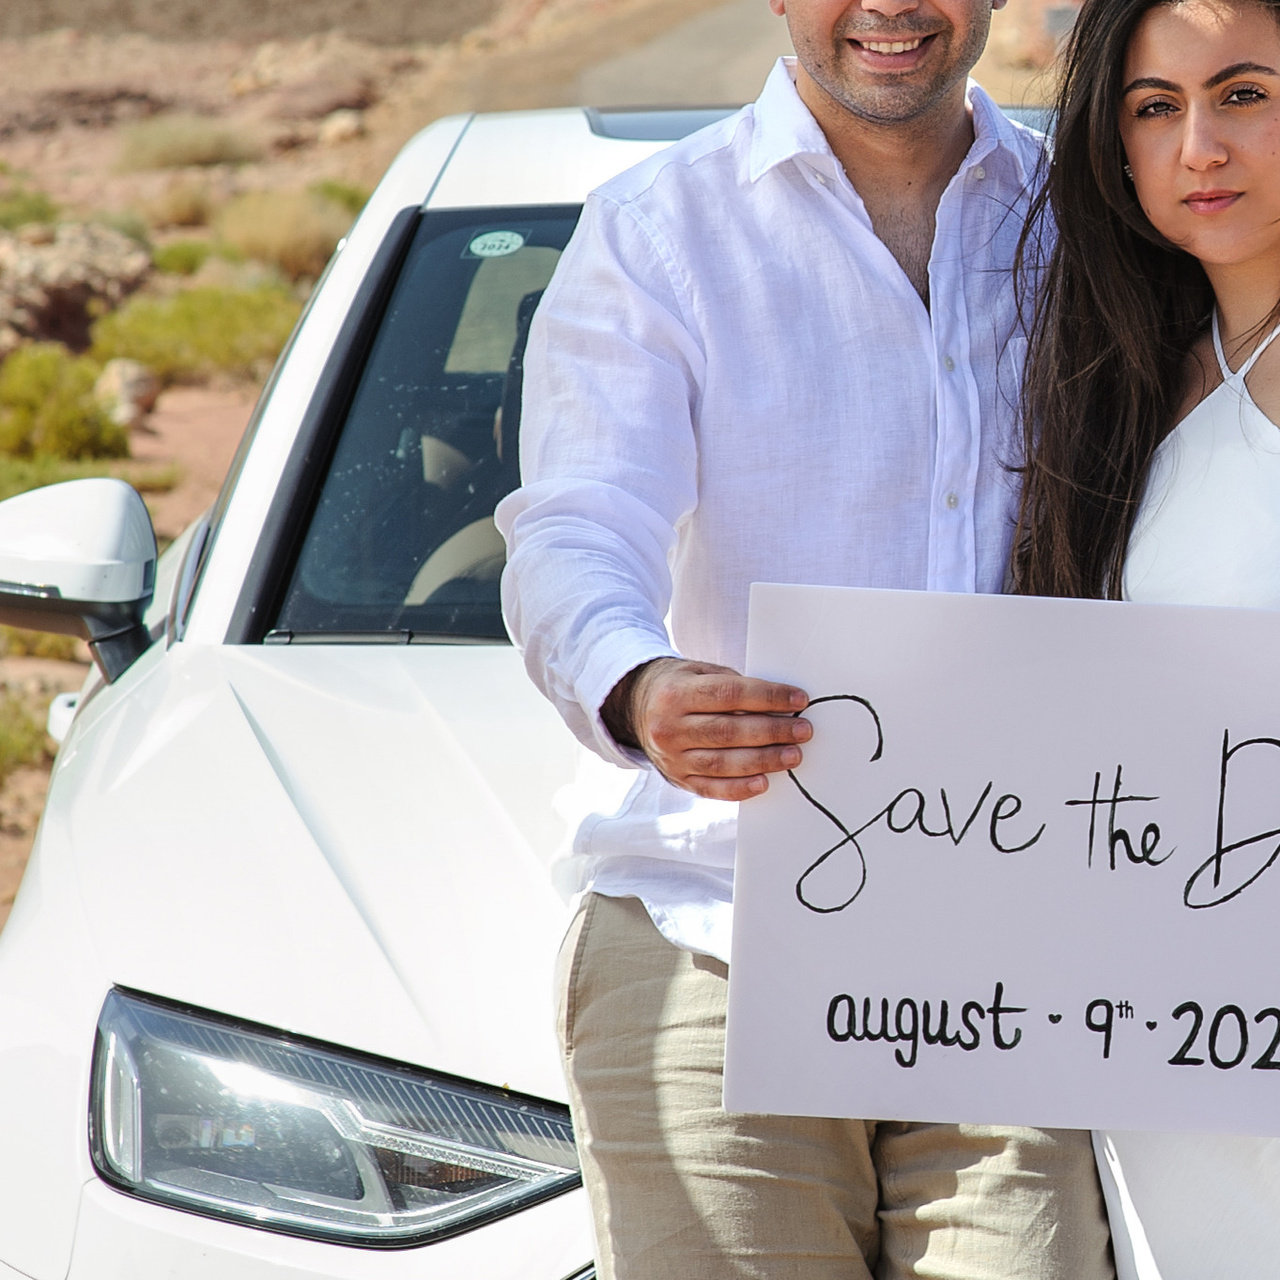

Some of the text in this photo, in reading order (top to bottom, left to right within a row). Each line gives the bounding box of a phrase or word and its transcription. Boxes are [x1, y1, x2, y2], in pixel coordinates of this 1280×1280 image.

[786, 693, 1046, 914] Save
[1065, 764, 1176, 871] the
[826, 981, 1029, 1068] august
[1085, 999, 1135, 1059] 9th
